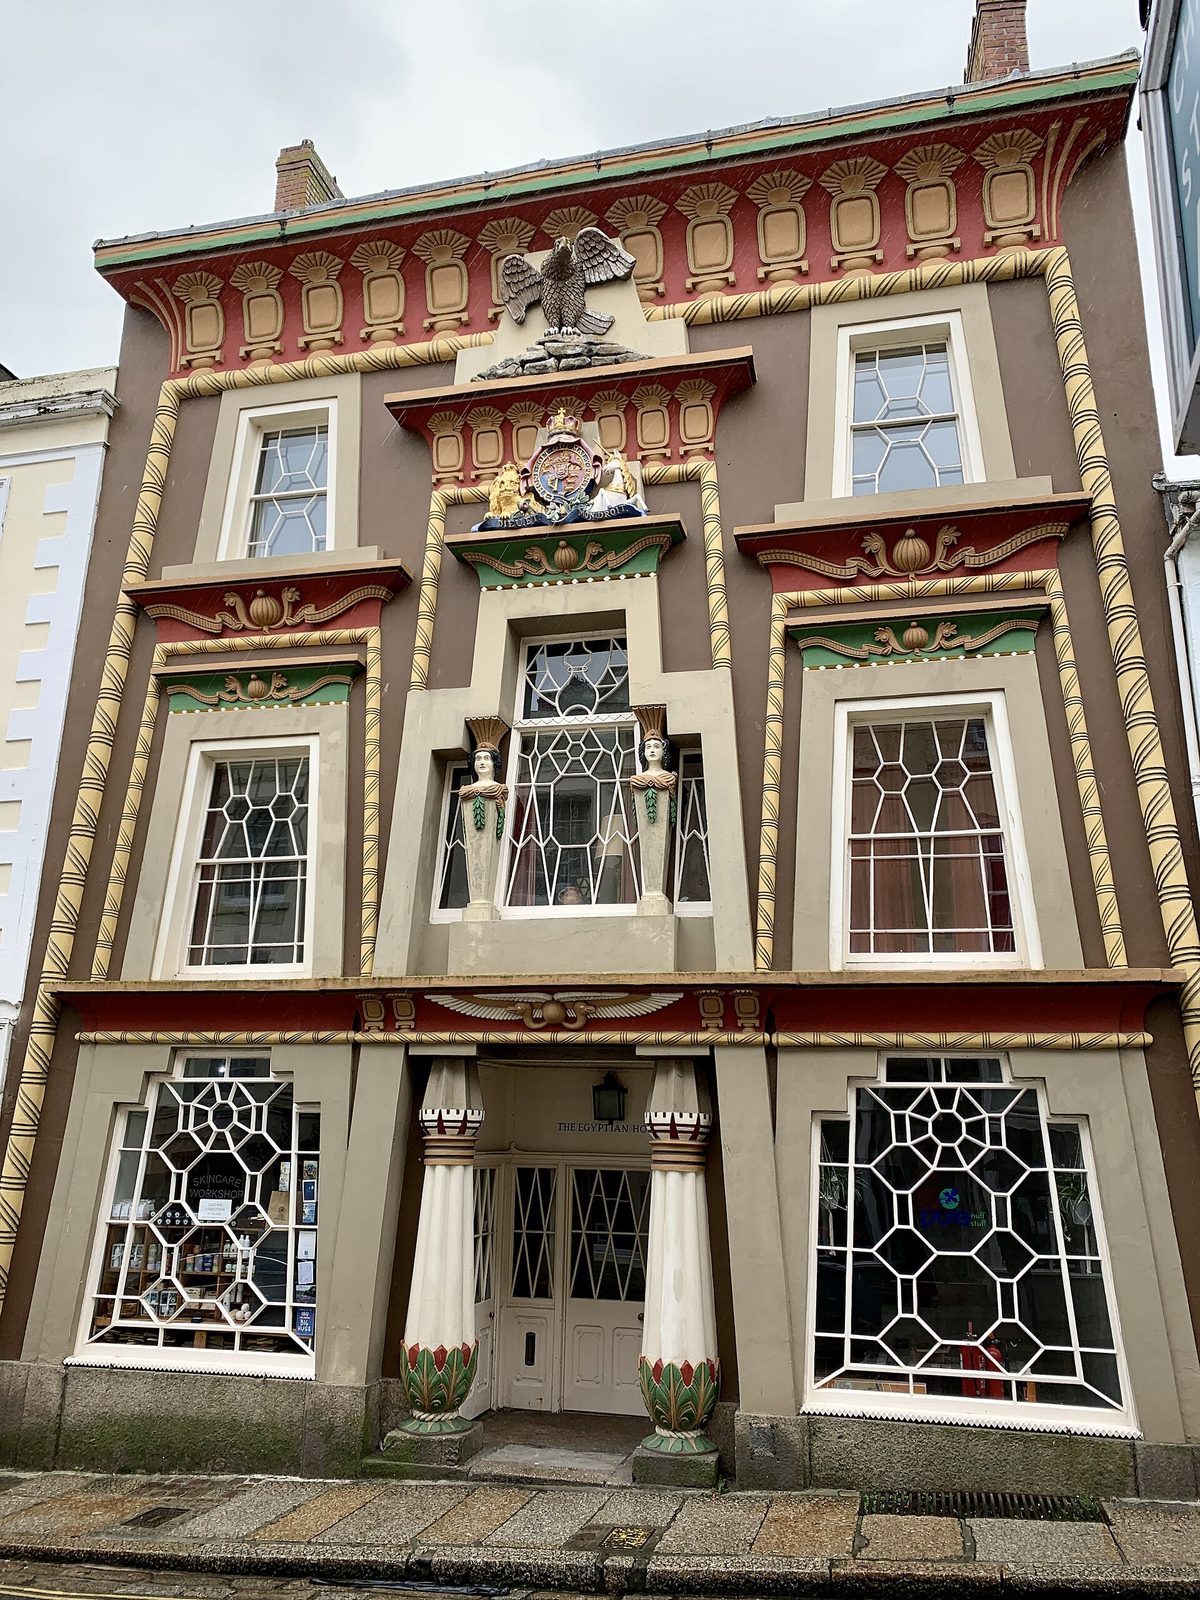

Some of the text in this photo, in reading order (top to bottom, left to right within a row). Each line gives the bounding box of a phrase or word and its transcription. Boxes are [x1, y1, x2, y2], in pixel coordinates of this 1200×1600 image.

[557, 1122, 576, 1132] THE
[578, 1123, 629, 1133] EGYPTIAN
[193, 1174, 242, 1188] SKINCARE
[189, 1188, 244, 1199] WORKSHOP
[920, 1209, 971, 1229] pure
[970, 1219, 987, 1227] stuff
